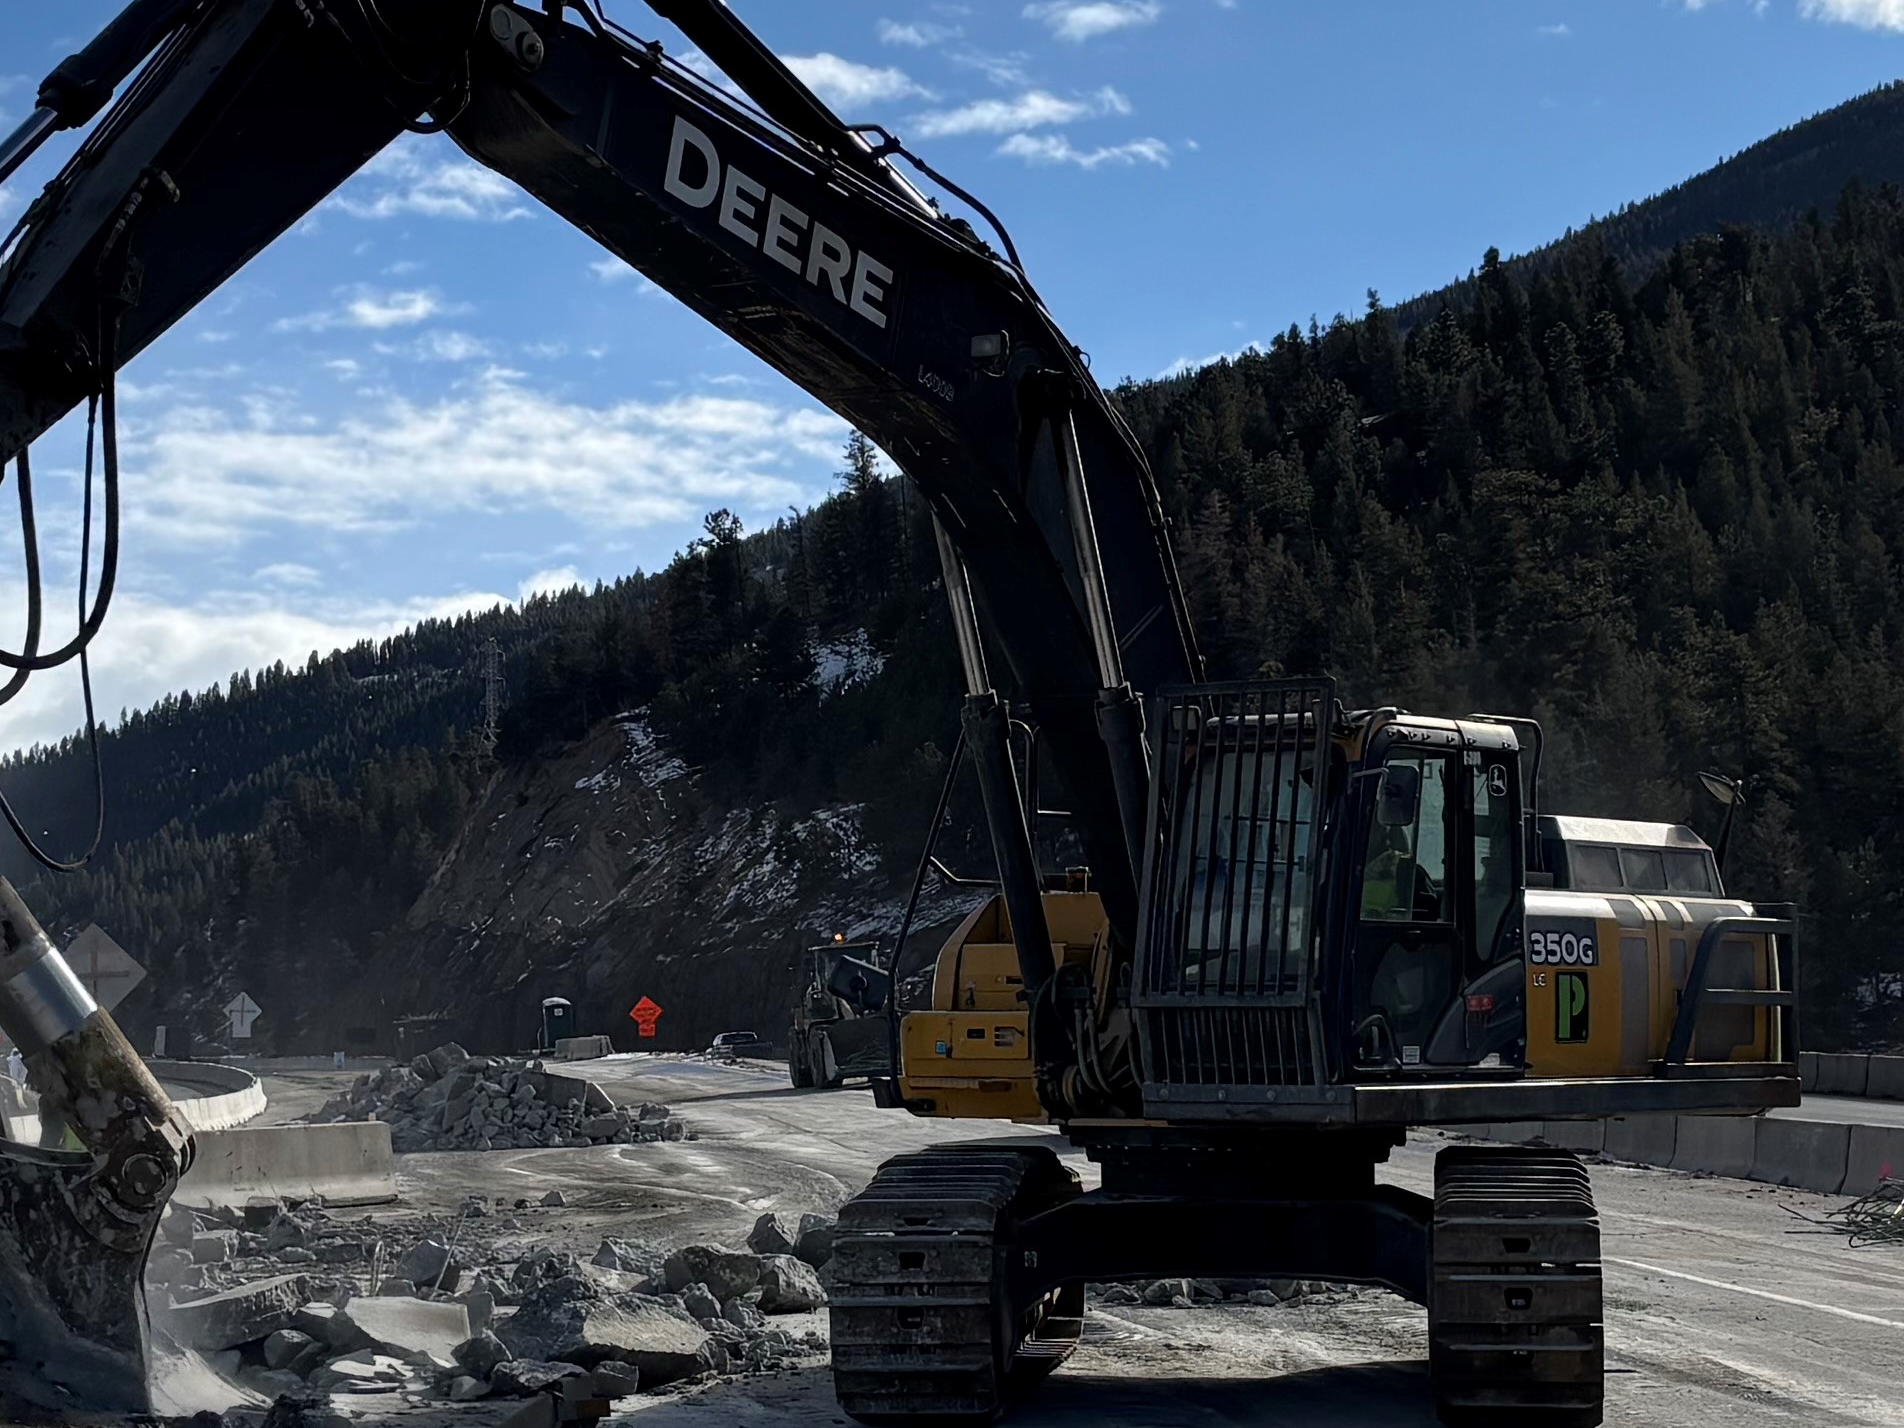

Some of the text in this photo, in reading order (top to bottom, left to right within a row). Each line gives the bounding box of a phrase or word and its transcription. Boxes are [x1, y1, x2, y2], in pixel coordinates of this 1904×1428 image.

[664, 115, 893, 329] DEERE
[1531, 932, 1594, 965] 350G
[1532, 973, 1547, 987] LC
